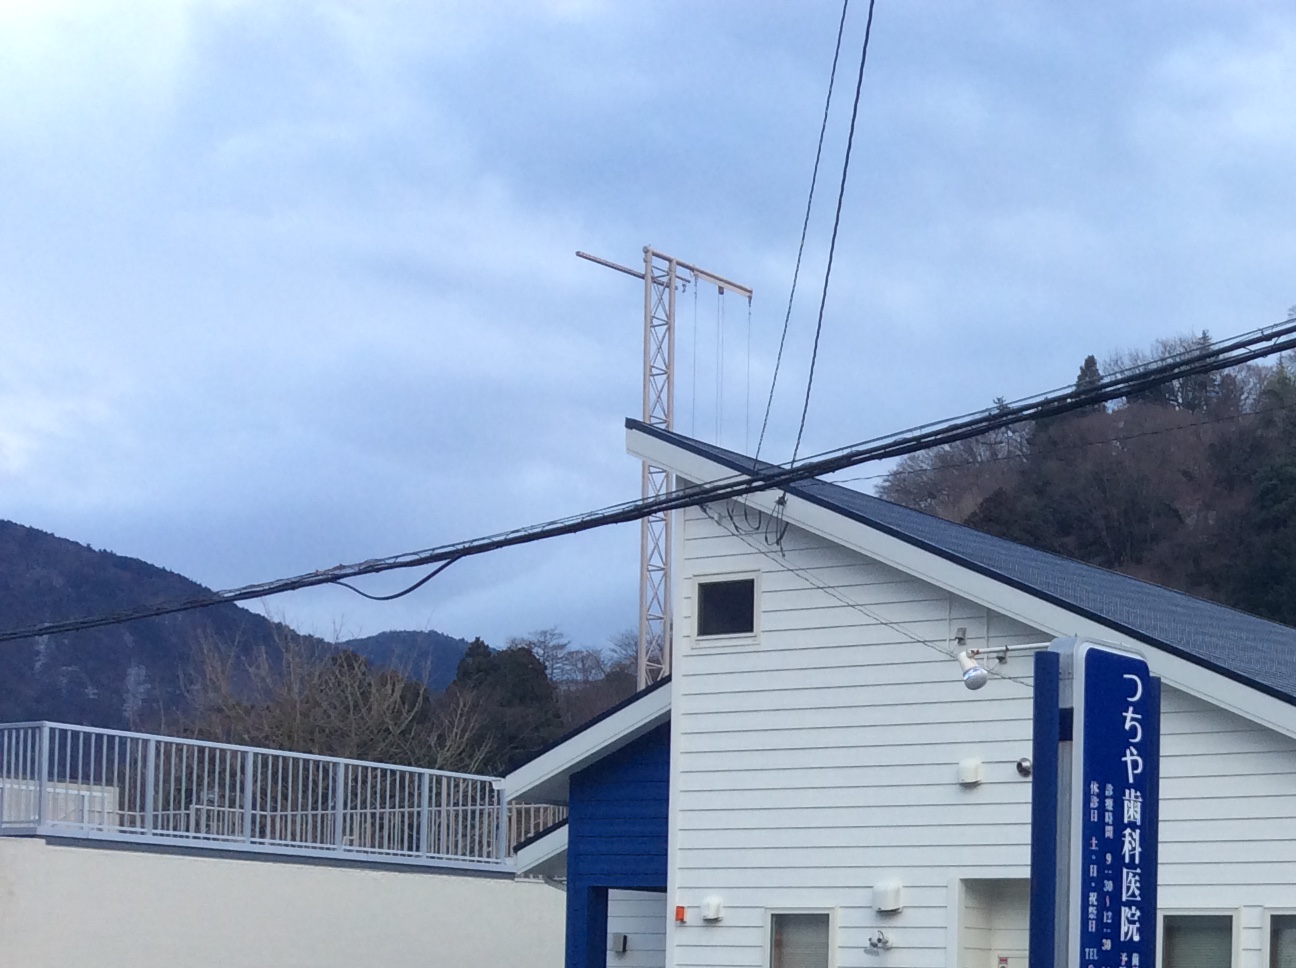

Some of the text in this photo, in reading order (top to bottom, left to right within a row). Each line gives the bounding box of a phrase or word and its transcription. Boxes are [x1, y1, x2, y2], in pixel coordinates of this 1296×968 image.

[1089, 780, 1100, 822] 休診日
[1119, 673, 1144, 942] つちや歯科医院
[1084, 947, 1099, 960] TEL
